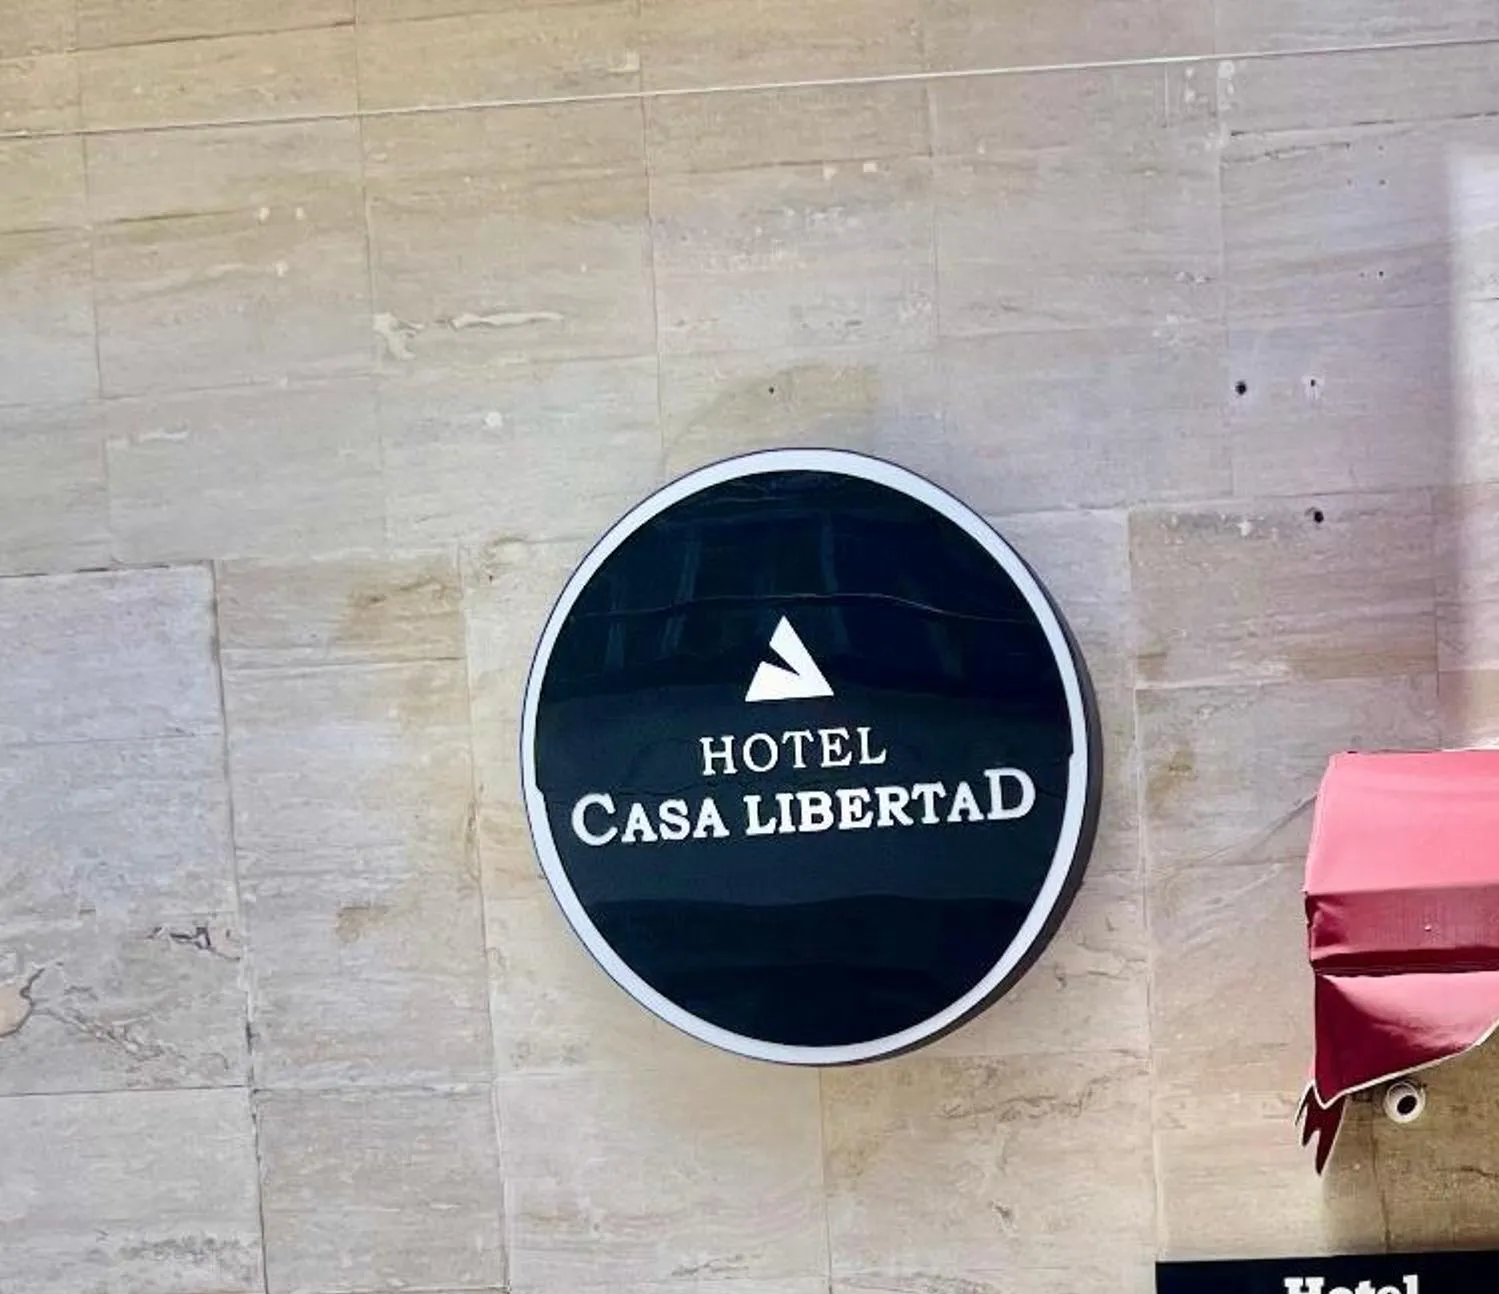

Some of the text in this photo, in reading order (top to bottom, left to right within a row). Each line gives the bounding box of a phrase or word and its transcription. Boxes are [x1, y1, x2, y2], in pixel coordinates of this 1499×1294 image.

[700, 727, 887, 776] HOTEL
[571, 767, 1037, 847] CASA LIBERTAD
